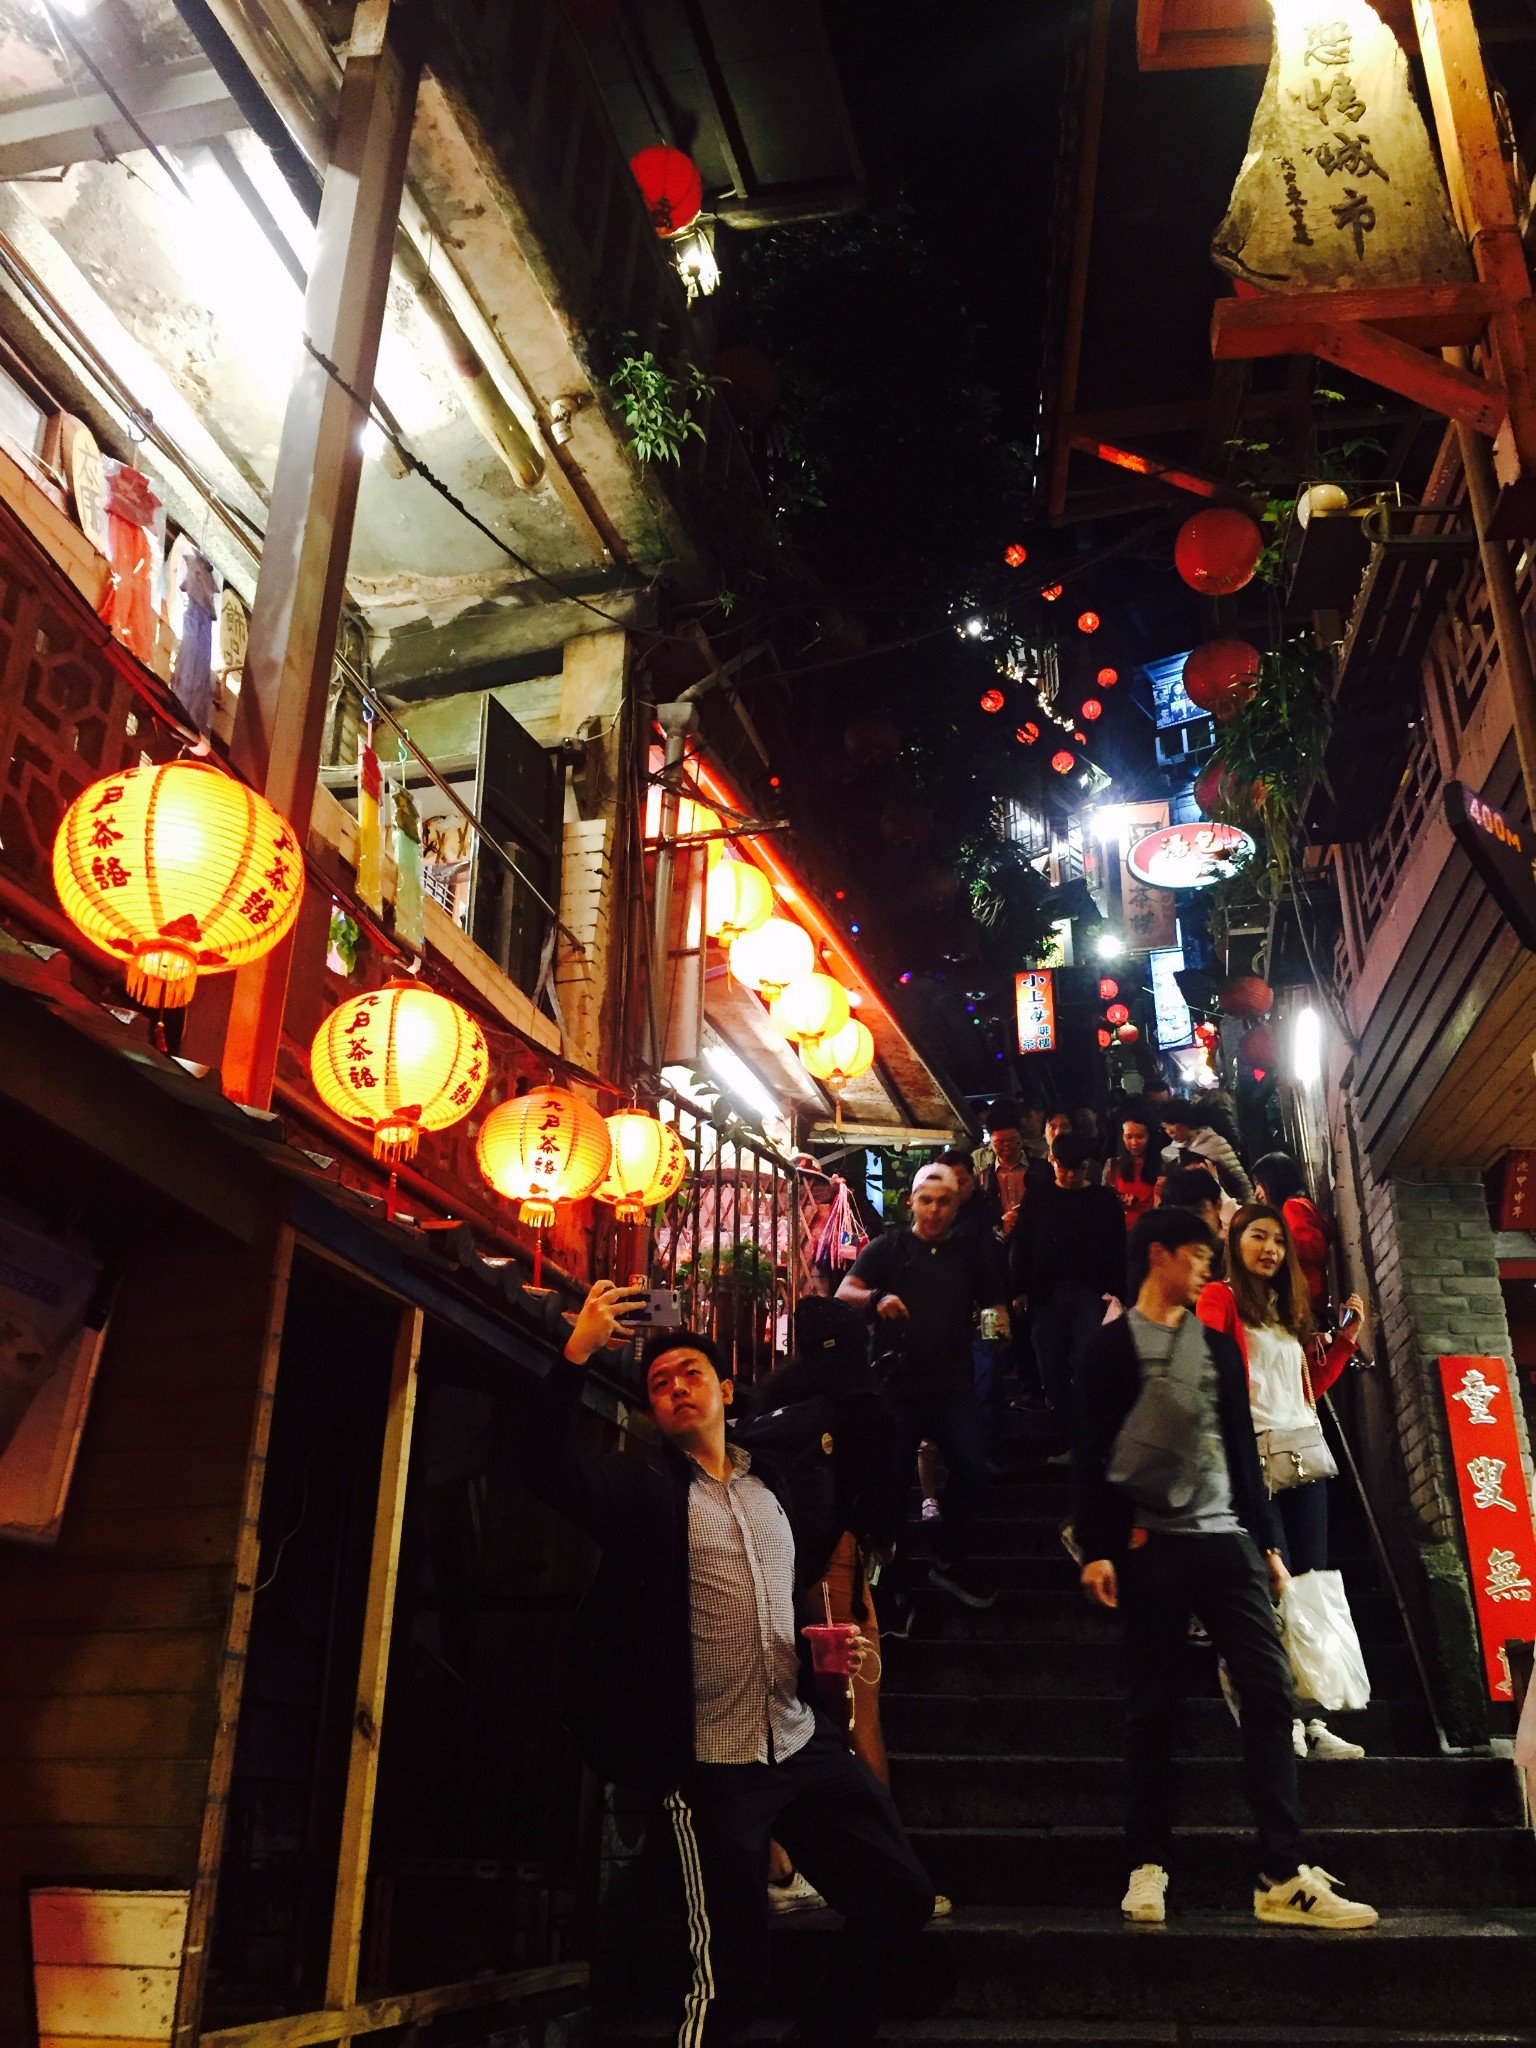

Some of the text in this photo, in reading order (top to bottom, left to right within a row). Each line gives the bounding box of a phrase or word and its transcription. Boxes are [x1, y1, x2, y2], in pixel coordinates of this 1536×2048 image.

[1452, 1368, 1532, 1696] 童叟無
[1288, 1889, 1317, 1912] N
